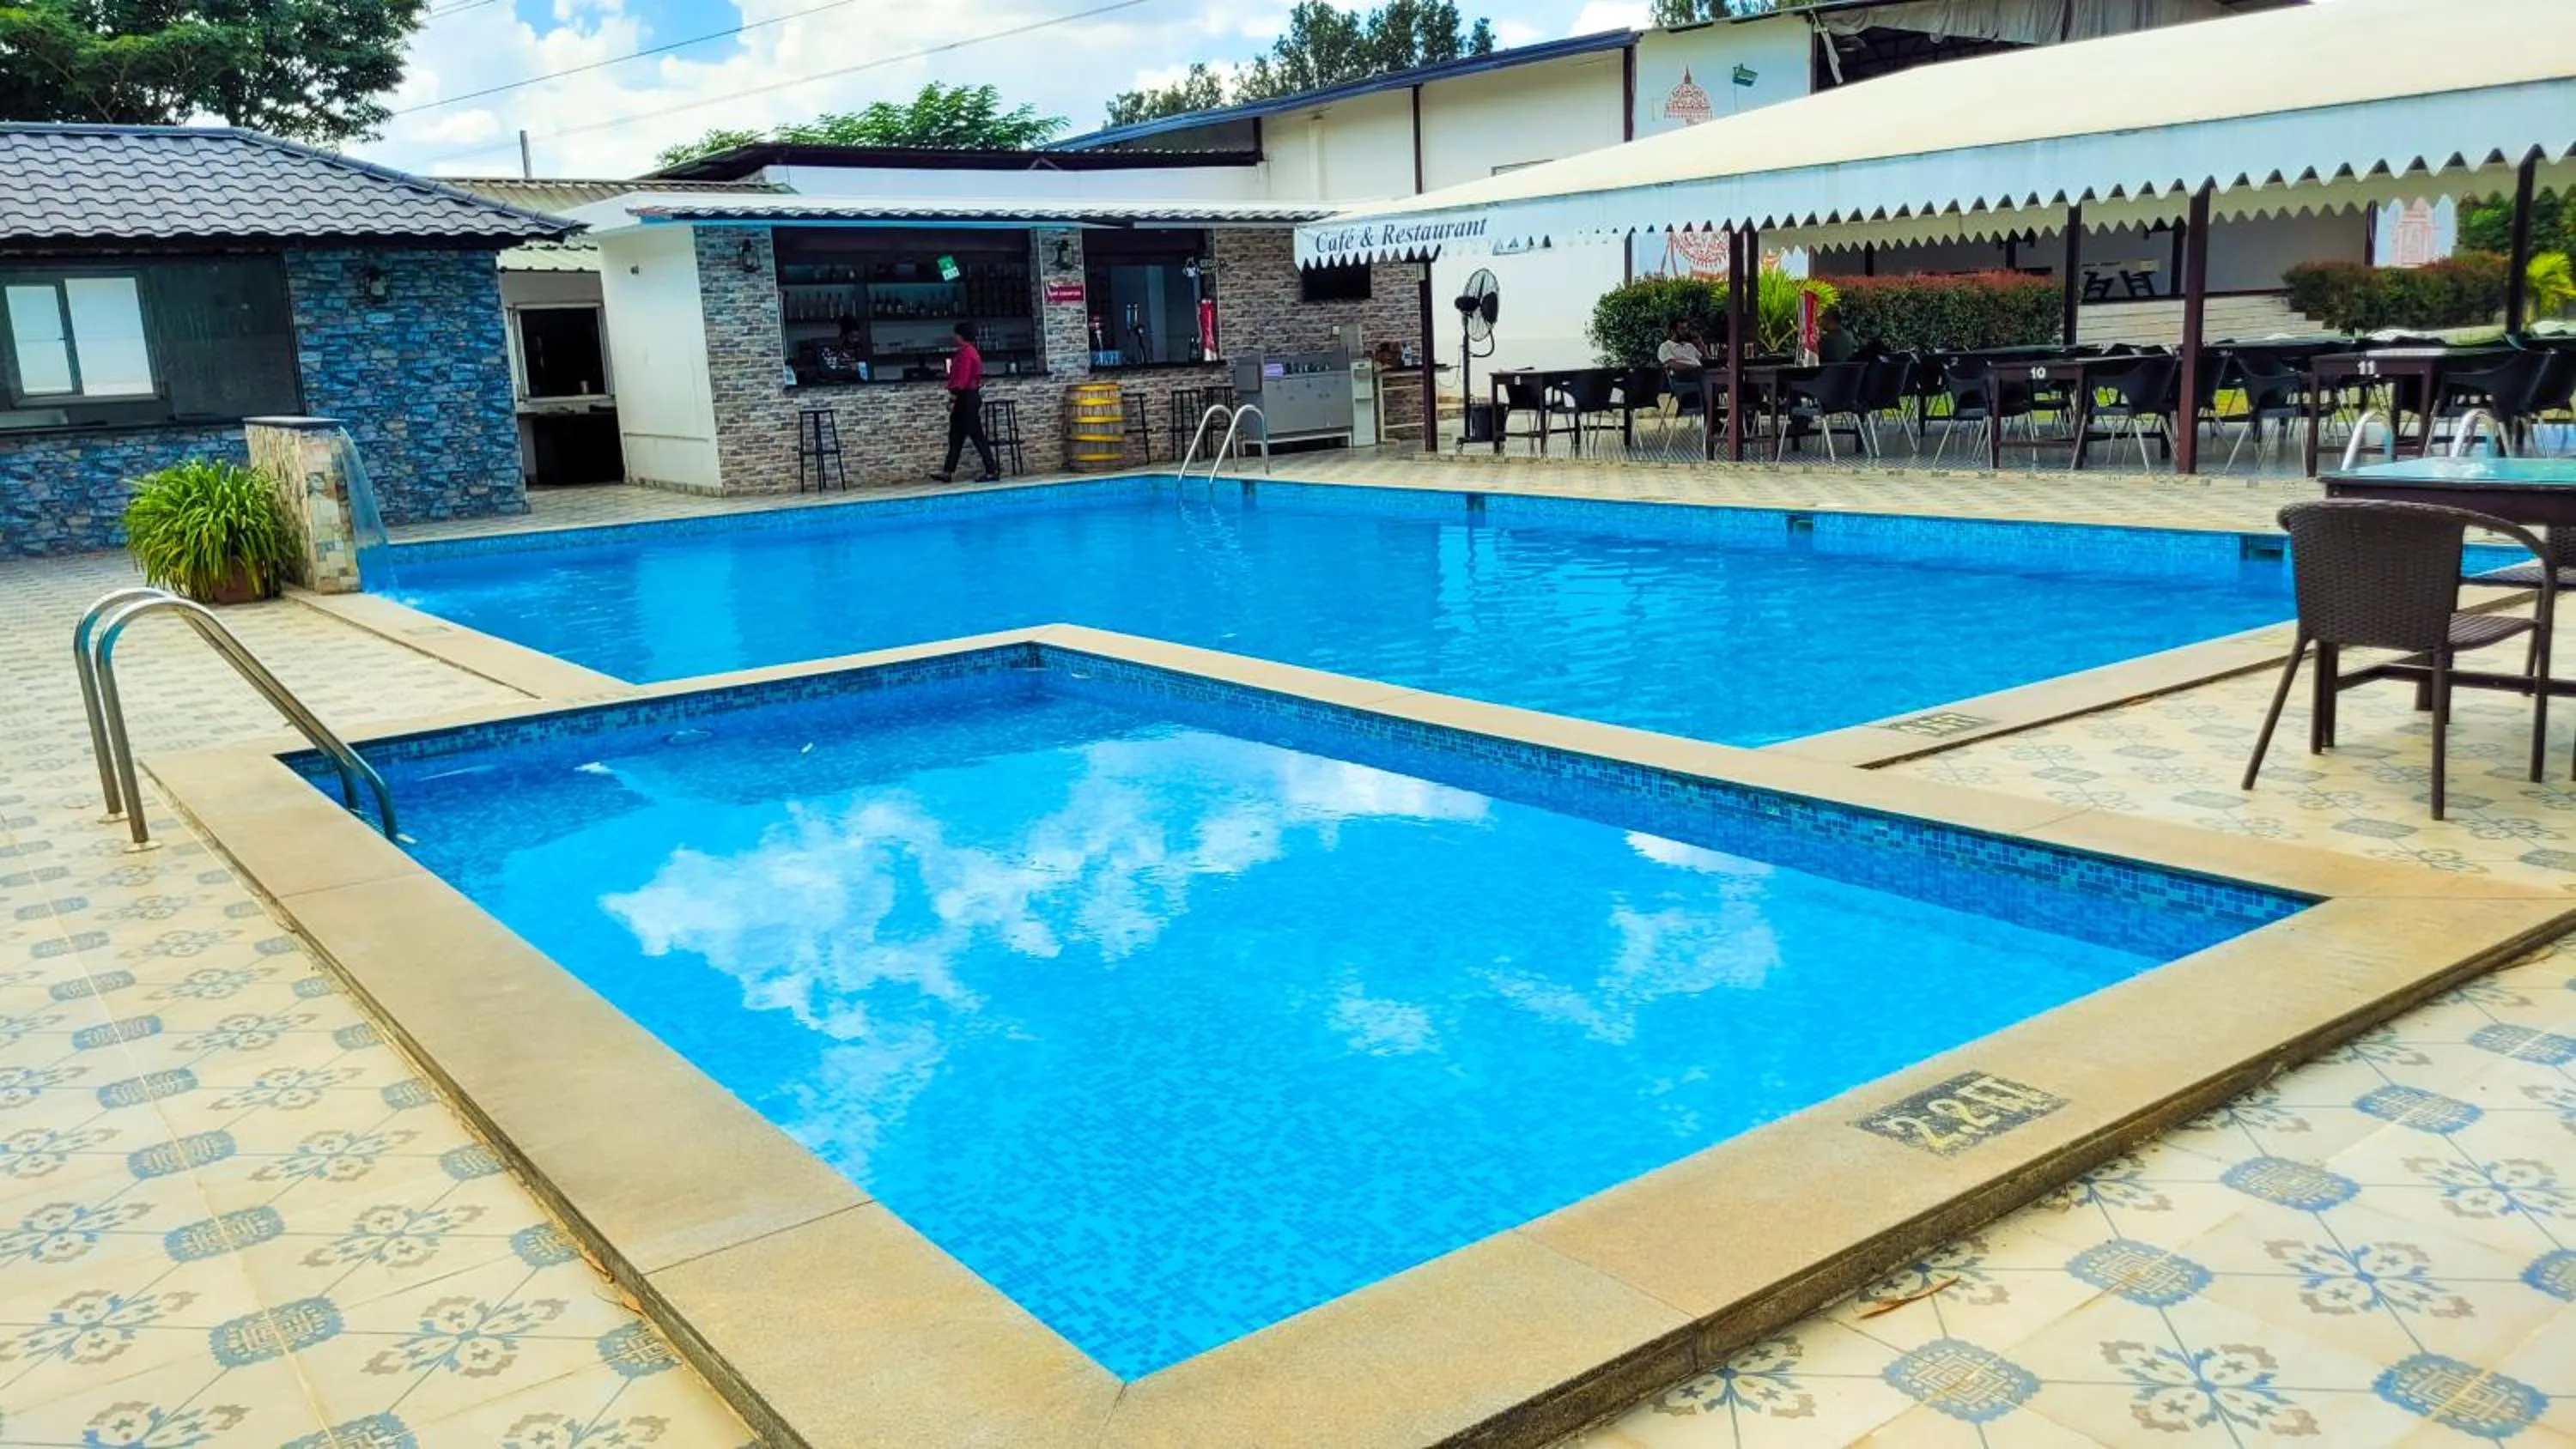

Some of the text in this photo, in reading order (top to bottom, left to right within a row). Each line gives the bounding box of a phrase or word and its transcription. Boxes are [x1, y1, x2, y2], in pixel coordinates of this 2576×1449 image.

[1315, 217, 1487, 254] Café & Restaurant
[2029, 366, 2047, 379] 10
[2357, 360, 2376, 375] 11
